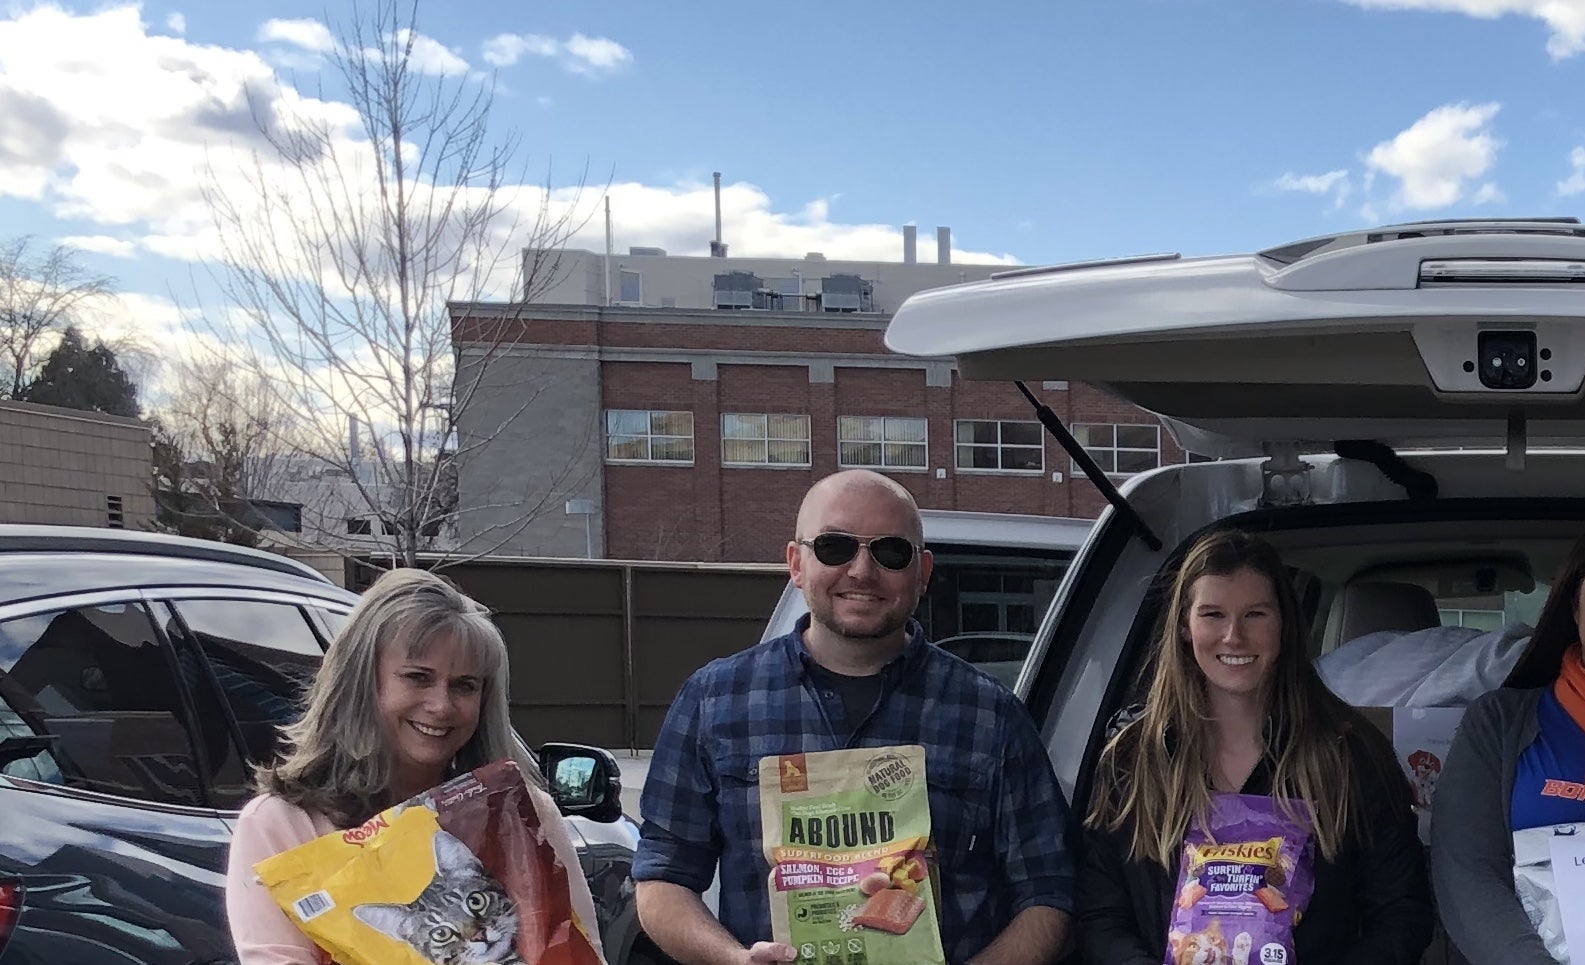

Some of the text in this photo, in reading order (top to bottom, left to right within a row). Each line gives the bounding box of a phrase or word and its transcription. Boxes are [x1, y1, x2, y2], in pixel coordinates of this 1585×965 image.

[868, 759, 906, 785] NATURAL
[873, 767, 911, 793] DOG FOOD
[789, 811, 895, 848] ABOUND
[780, 848, 851, 862] SUPERFOOD
[781, 863, 854, 876] SALMON, EGG &
[1208, 864, 1244, 876] SURFIN'
[782, 874, 860, 887] PUMPKIN RECIPE
[1227, 873, 1264, 884] TURFIN'
[1210, 882, 1254, 892] FAVORITES
[1264, 948, 1283, 960] 3.15
